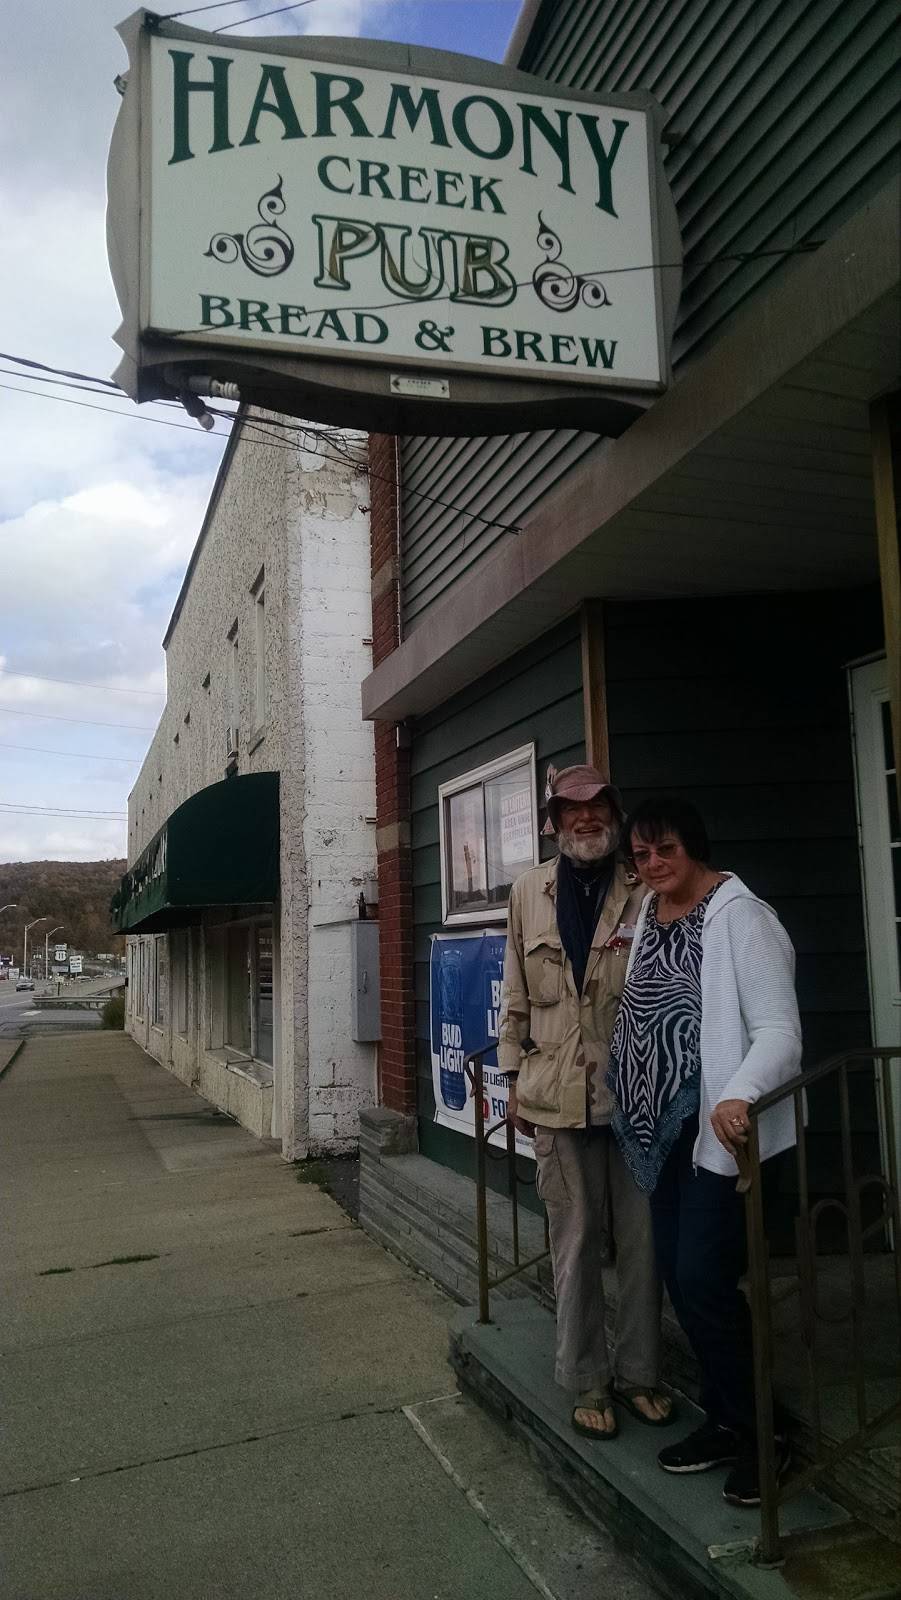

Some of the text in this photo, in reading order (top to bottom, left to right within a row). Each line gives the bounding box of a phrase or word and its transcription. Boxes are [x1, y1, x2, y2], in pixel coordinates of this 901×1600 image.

[168, 49, 630, 220] HARMONY
[317, 155, 507, 215] CREEK
[312, 214, 518, 308] PUB
[199, 293, 618, 370] BREAD & BREW
[440, 1045, 465, 1074] LIGHT
[441, 1022, 462, 1049] BUD
